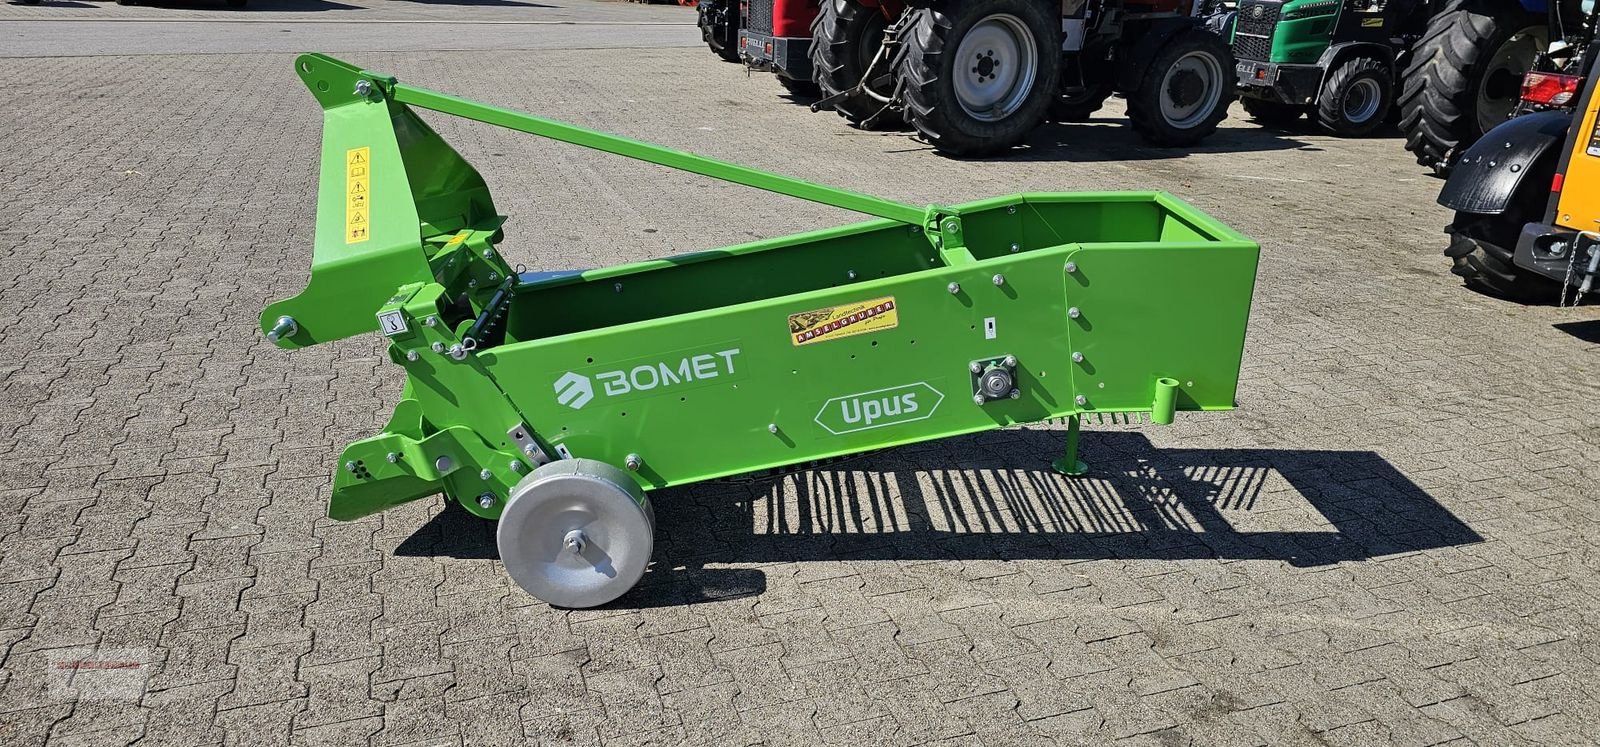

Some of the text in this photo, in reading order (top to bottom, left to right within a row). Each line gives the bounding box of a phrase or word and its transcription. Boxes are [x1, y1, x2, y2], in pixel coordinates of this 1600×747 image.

[797, 301, 894, 342] AMSELGRUBER
[596, 348, 740, 396] BOMET
[841, 392, 919, 425] Upus
